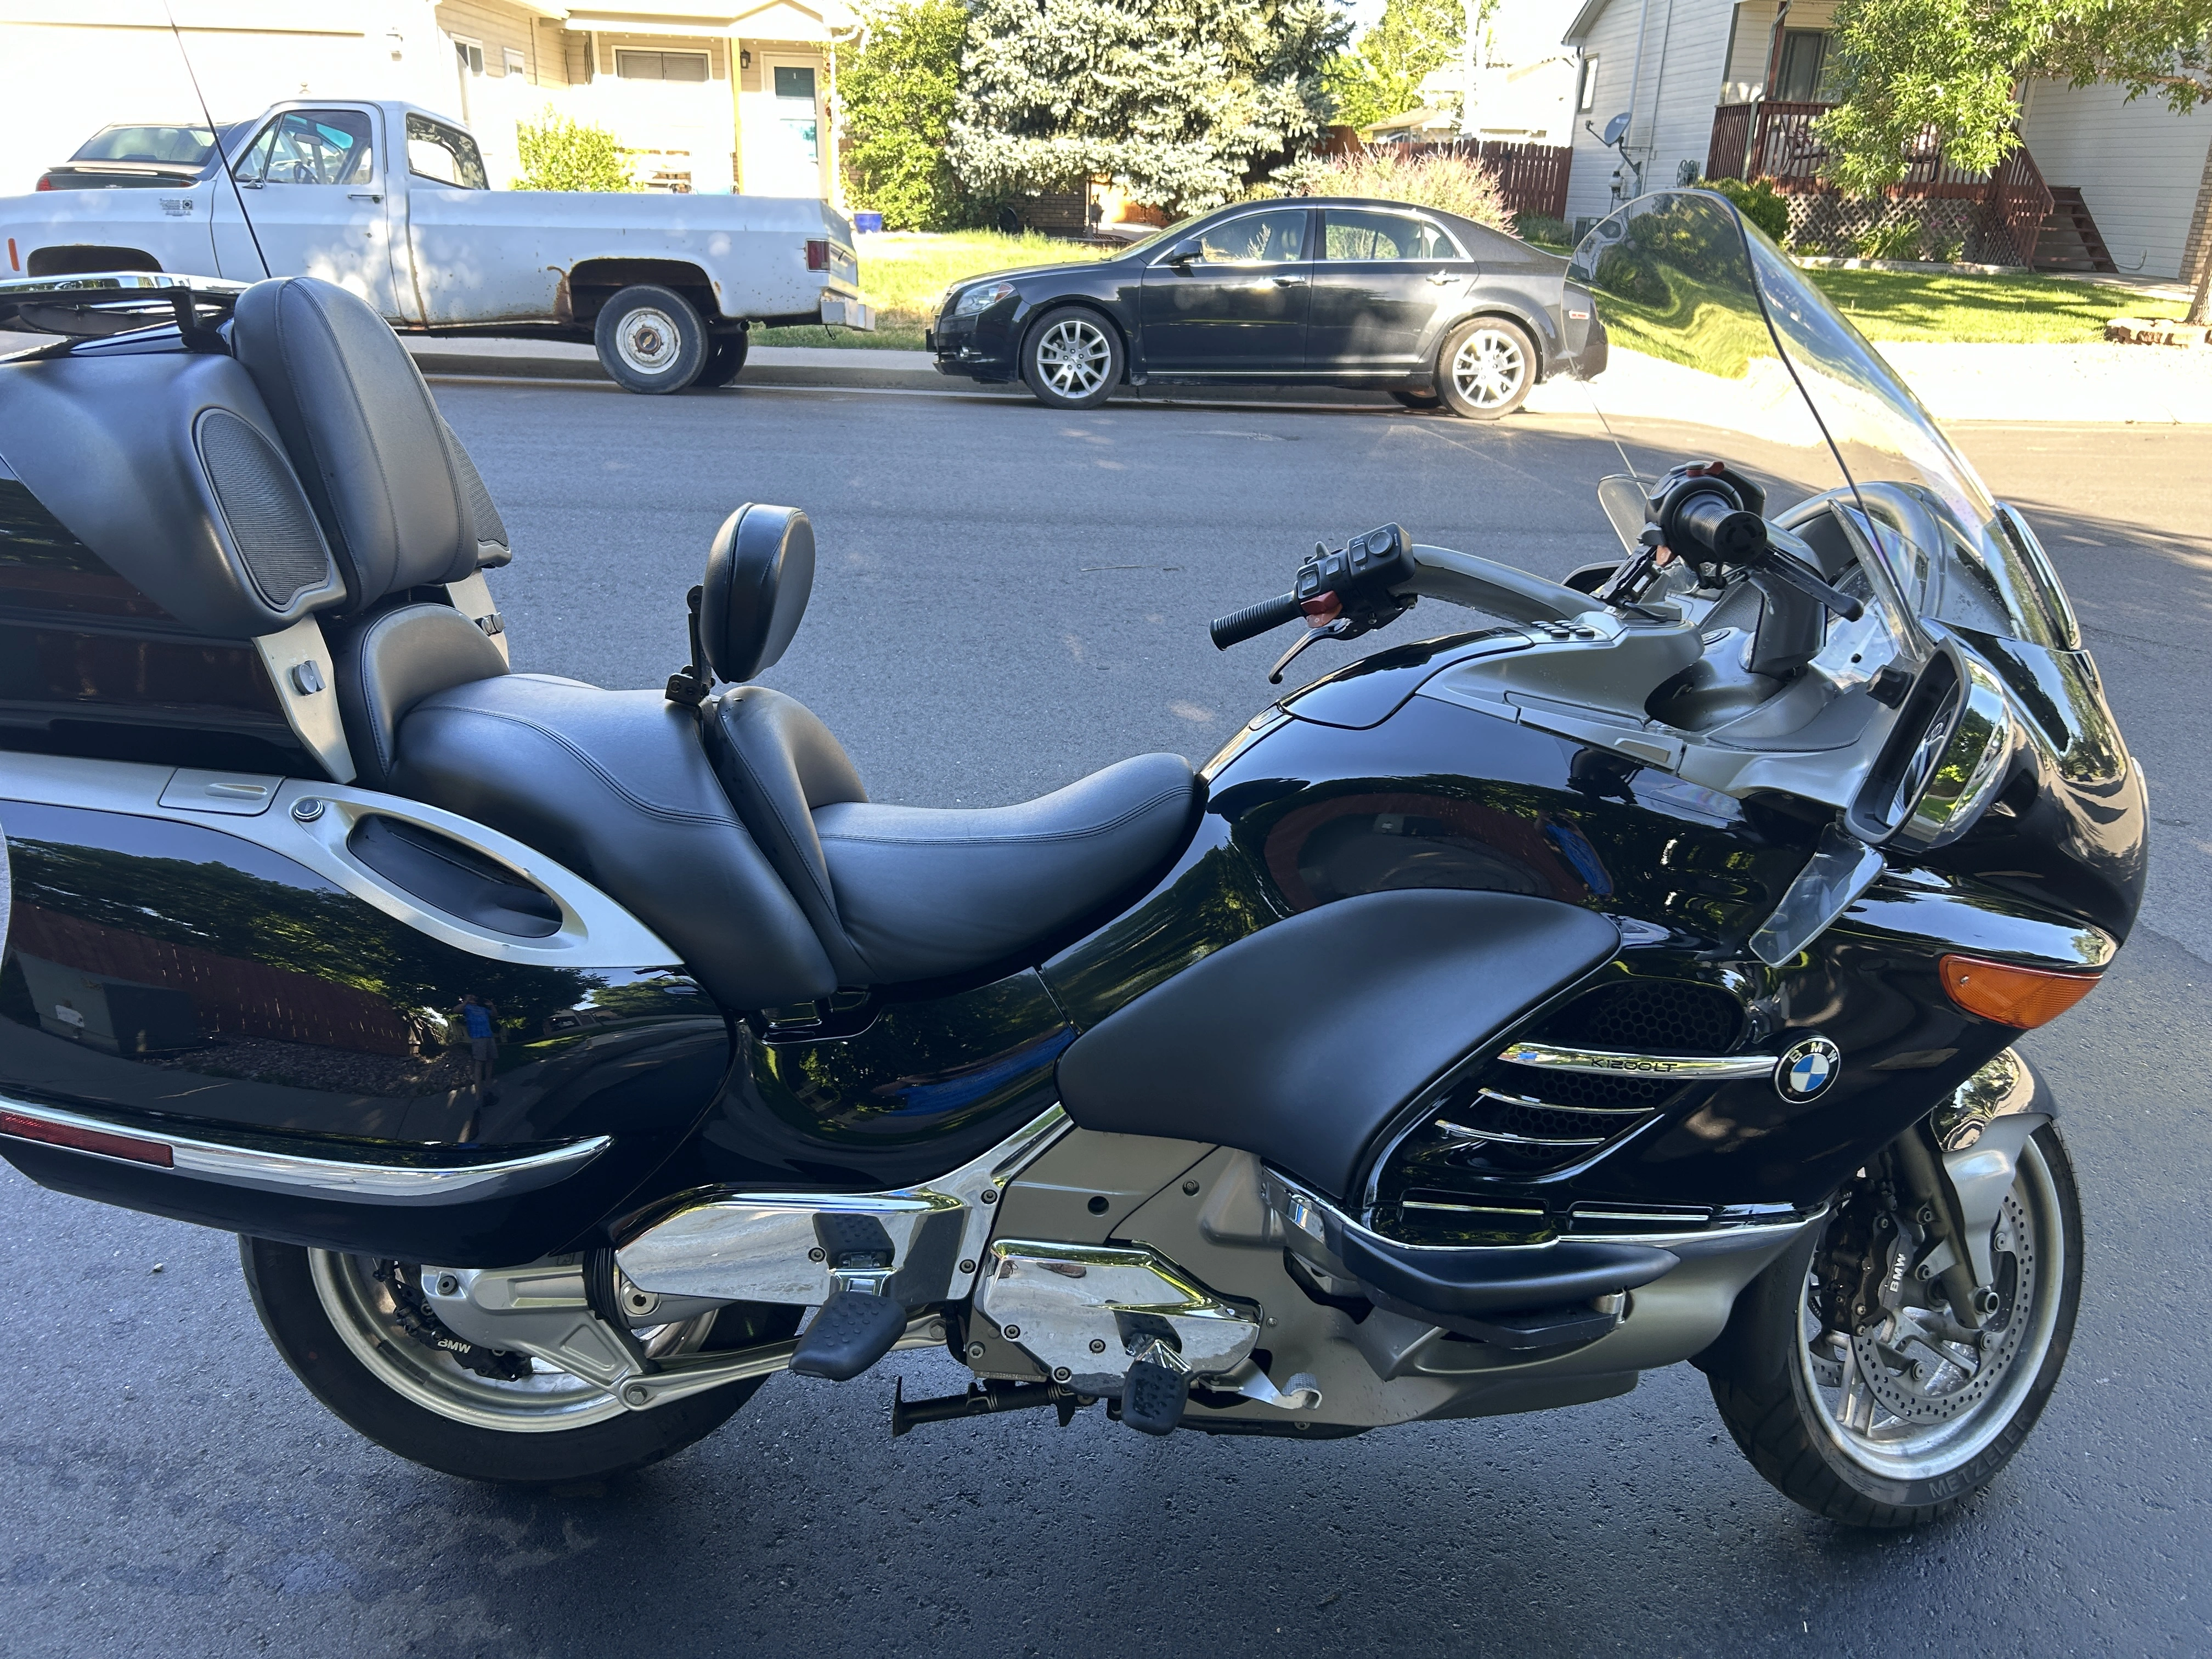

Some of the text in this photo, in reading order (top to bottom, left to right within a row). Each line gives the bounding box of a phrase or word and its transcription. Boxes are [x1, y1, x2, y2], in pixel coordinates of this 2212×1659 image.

[1788, 1042, 1838, 1063] BMW
[1591, 1058, 1678, 1073] K1200LT
[1889, 1253, 1906, 1292] BMW
[438, 1339, 471, 1353] BMW
[1928, 1409, 2034, 1499] METZELER
